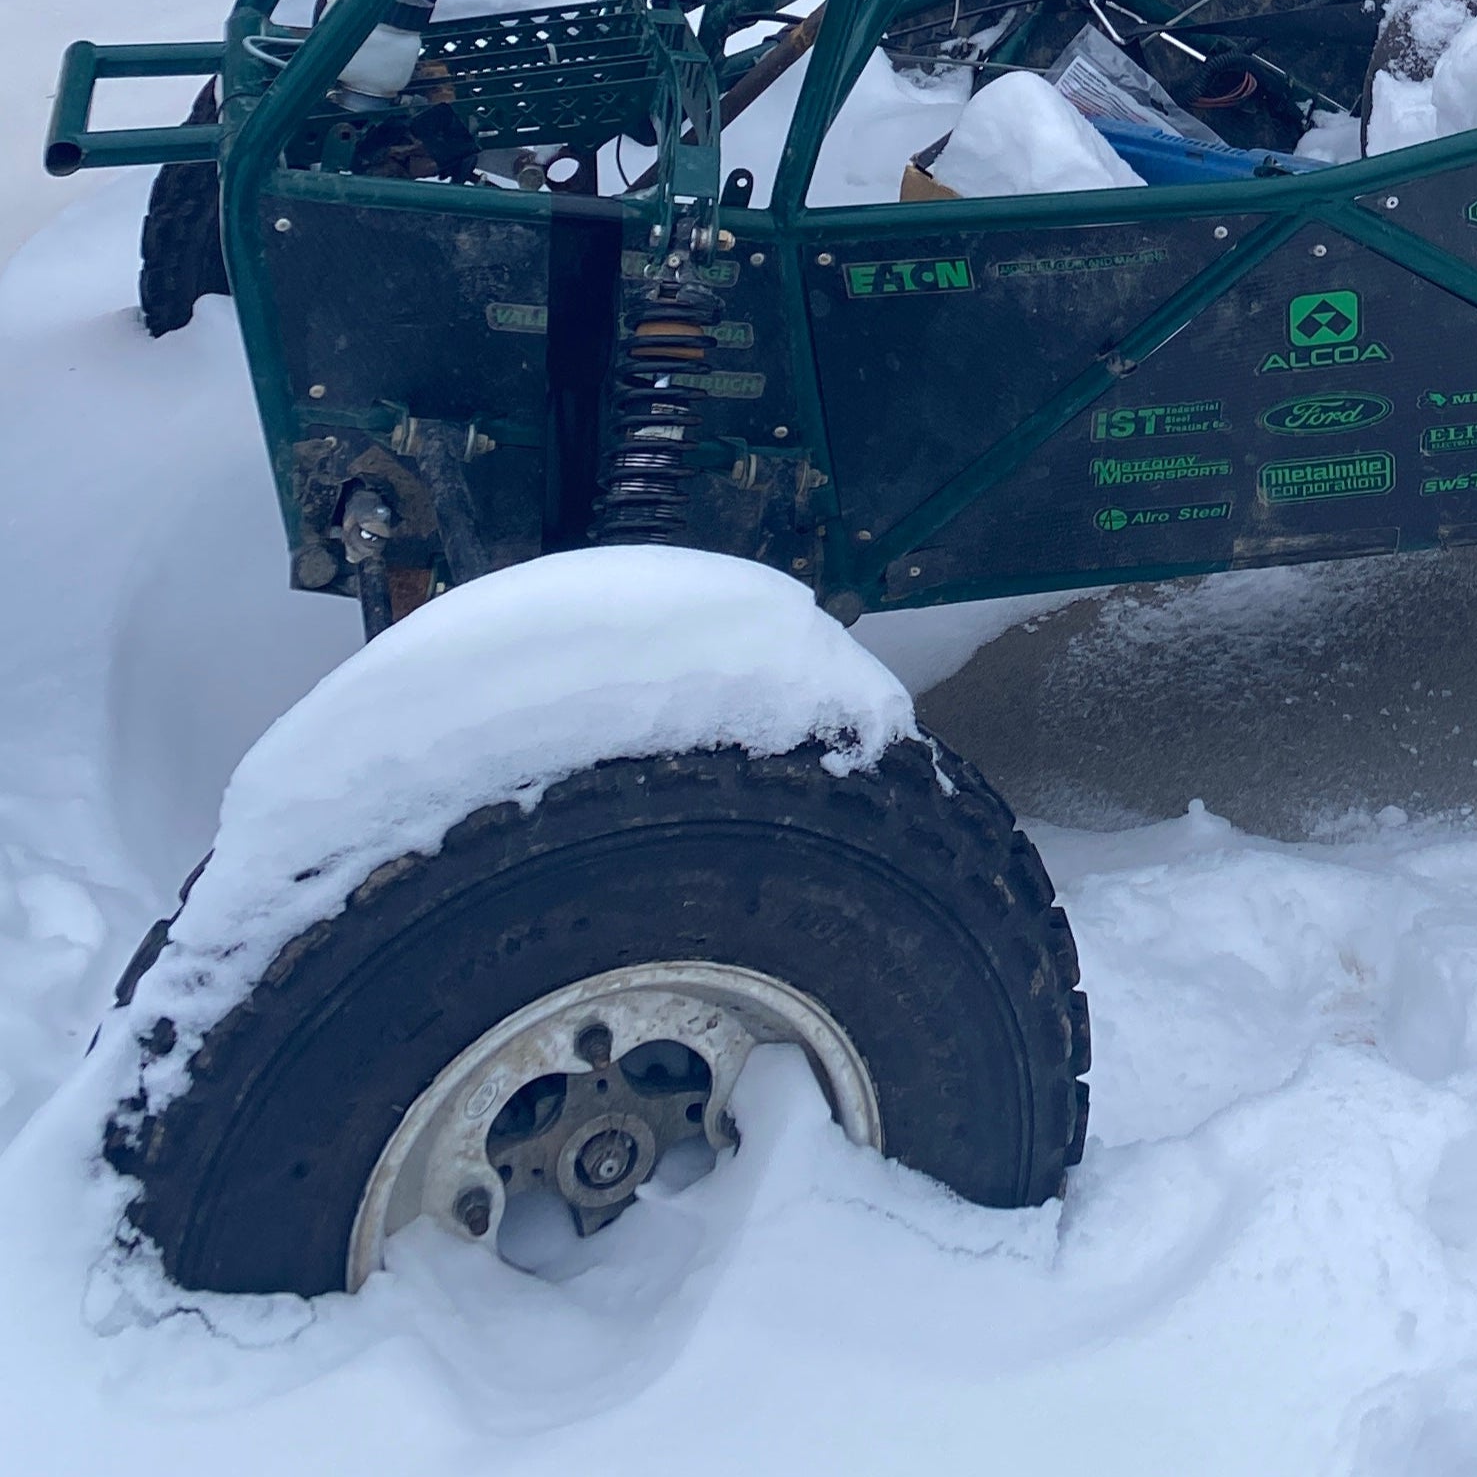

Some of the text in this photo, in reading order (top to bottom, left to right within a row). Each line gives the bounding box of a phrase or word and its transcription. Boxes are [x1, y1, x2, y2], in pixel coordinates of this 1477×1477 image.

[849, 260, 970, 294] EATON
[1261, 344, 1387, 372] ALCOA
[1165, 402, 1219, 415] Industrial
[1285, 400, 1364, 427] Ford
[1096, 408, 1165, 439] IST
[1165, 415, 1190, 424] Steel
[1165, 421, 1209, 433] Treating
[1272, 476, 1383, 497] corporation
[1131, 504, 1227, 524] Alro Steel
